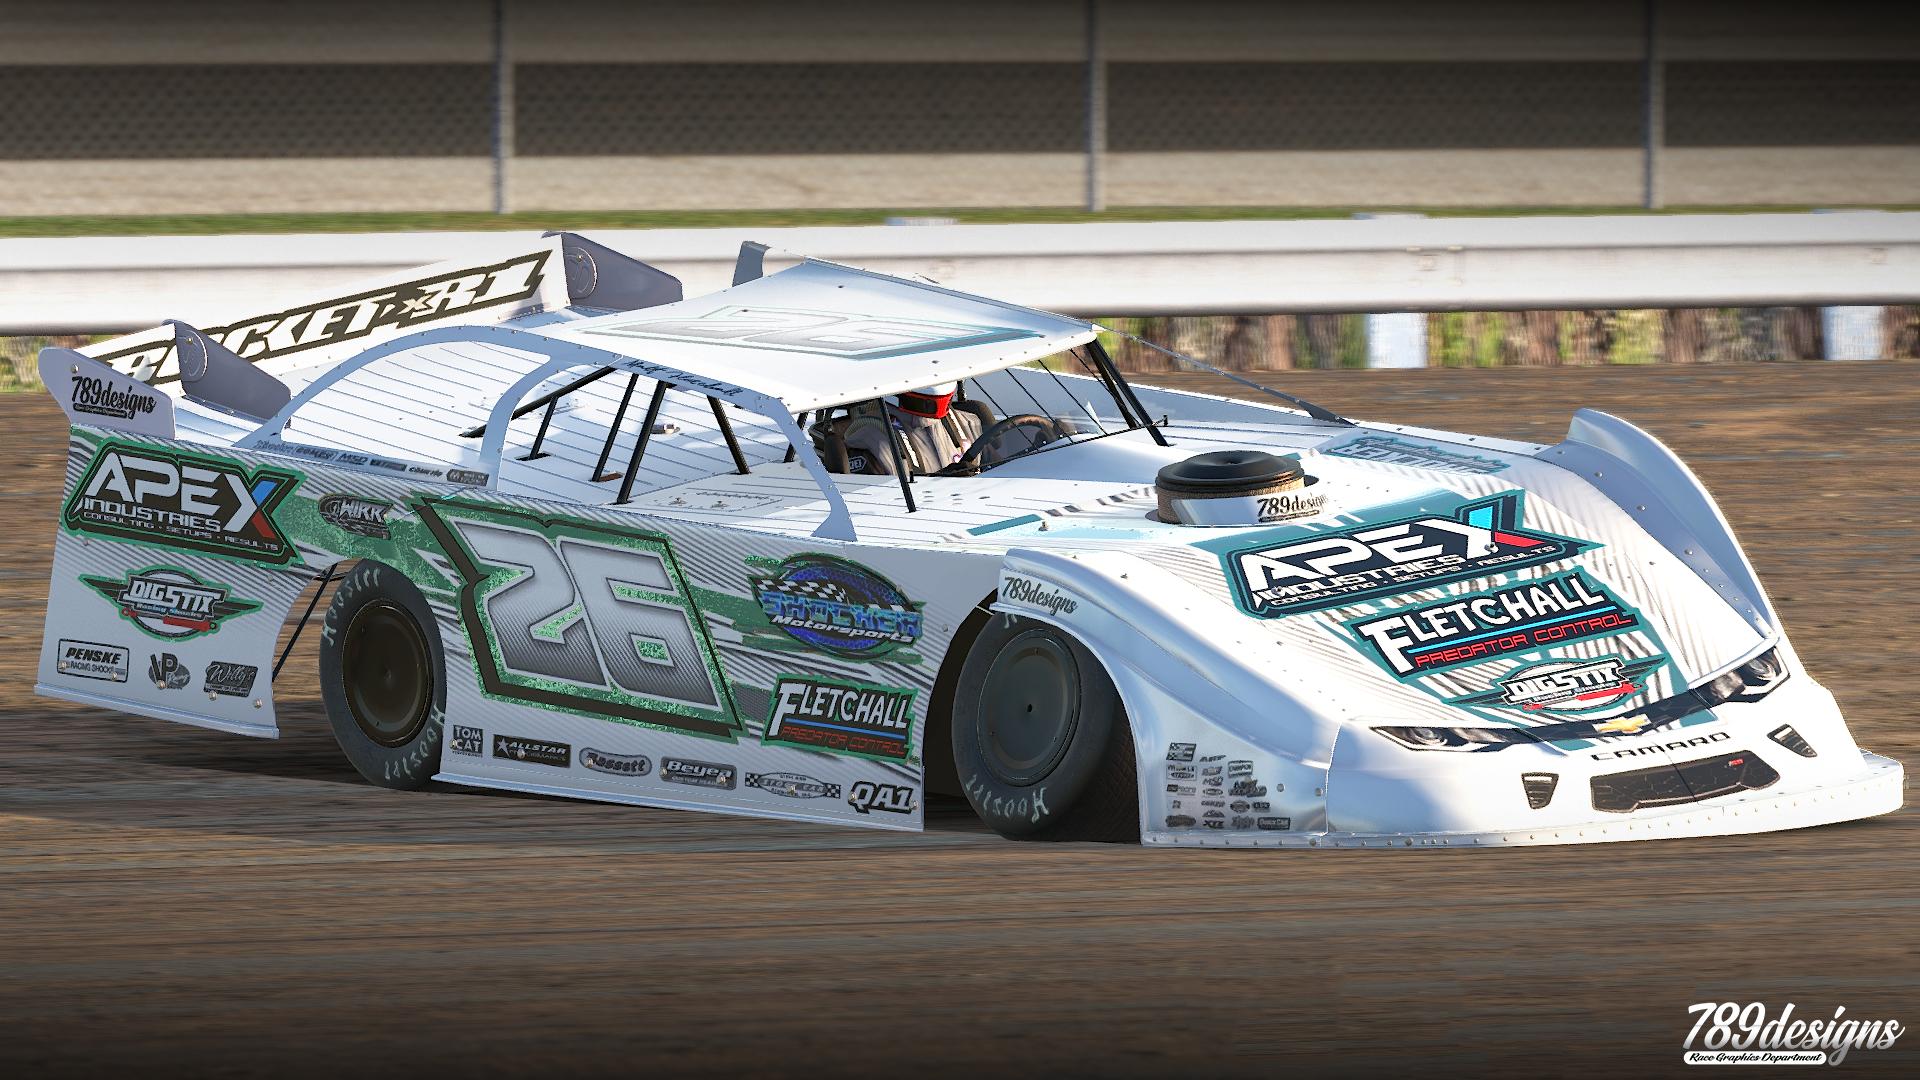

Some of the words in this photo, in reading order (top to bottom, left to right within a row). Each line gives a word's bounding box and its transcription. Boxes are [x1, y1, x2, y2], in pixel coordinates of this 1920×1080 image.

[71, 375, 158, 420] 789designs
[84, 451, 278, 539] APEX
[81, 497, 221, 533] INDUSTRIES
[84, 511, 155, 529] CONSULTING
[166, 526, 212, 540] SETUPS
[224, 535, 279, 551] RESULTS
[1241, 506, 1546, 591] APEX
[122, 580, 222, 613] DIGSTIX
[1002, 576, 1079, 617] 789designs
[1270, 580, 1378, 606] CONSULTING
[450, 516, 724, 713] 26
[771, 615, 915, 644] Motorsports
[1359, 574, 1605, 675] FLETCHALL
[65, 647, 122, 665] PENSKE
[1415, 633, 1529, 668] PREDATOR
[1534, 612, 1632, 643] CONTROL
[150, 652, 179, 687] VP
[1504, 661, 1622, 702] DIGSTIX
[769, 682, 908, 737] FLETCHALL
[454, 725, 482, 741] TOM
[455, 738, 481, 753] CAT
[508, 741, 566, 755] ALLSTAR
[1591, 731, 1731, 762] CAMARO
[850, 781, 914, 814] QA1
